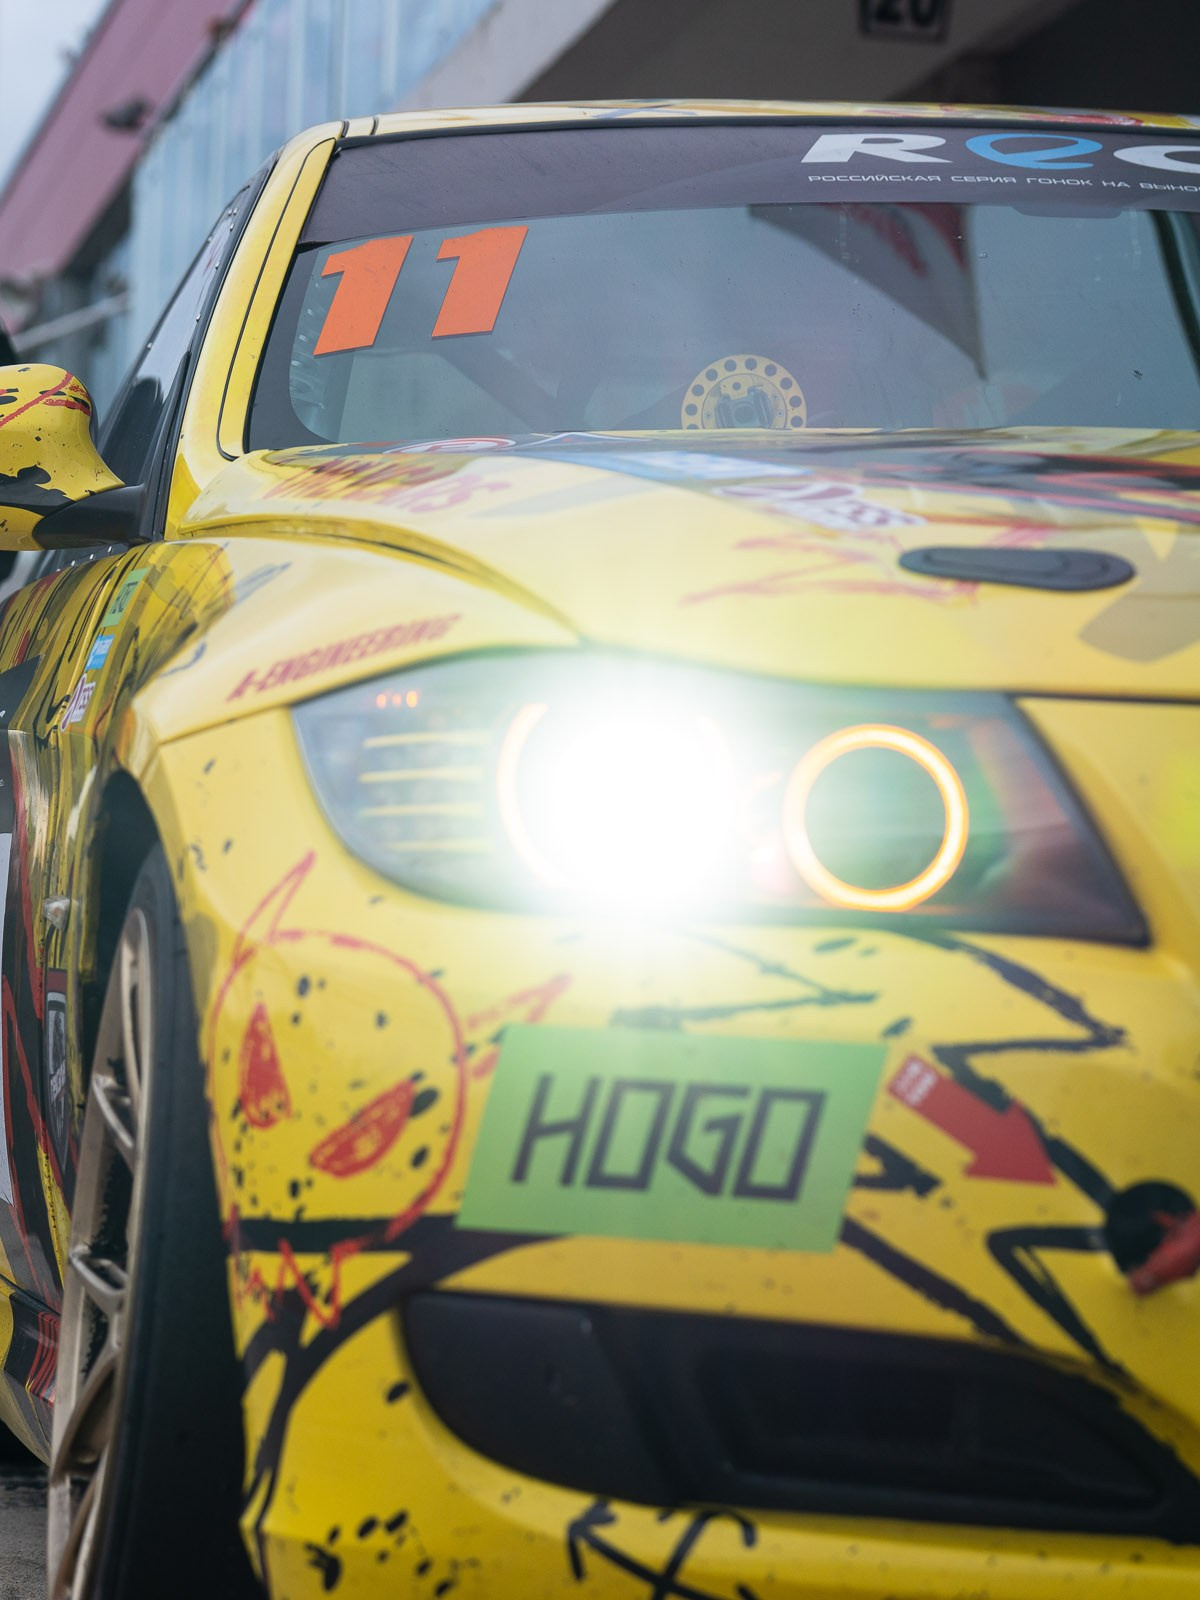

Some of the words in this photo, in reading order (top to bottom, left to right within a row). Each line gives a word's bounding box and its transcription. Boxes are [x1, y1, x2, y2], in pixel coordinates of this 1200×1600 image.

[808, 174, 941, 182] РОССИЙСКАЯ
[951, 175, 1016, 184] СЕРИЯ
[1026, 177, 1093, 187] ГОНОК
[1102, 180, 1130, 188] НА
[1139, 182, 1200, 192] ВЫНО
[312, 225, 529, 356] 11
[510, 1073, 828, 1203] HOGO
